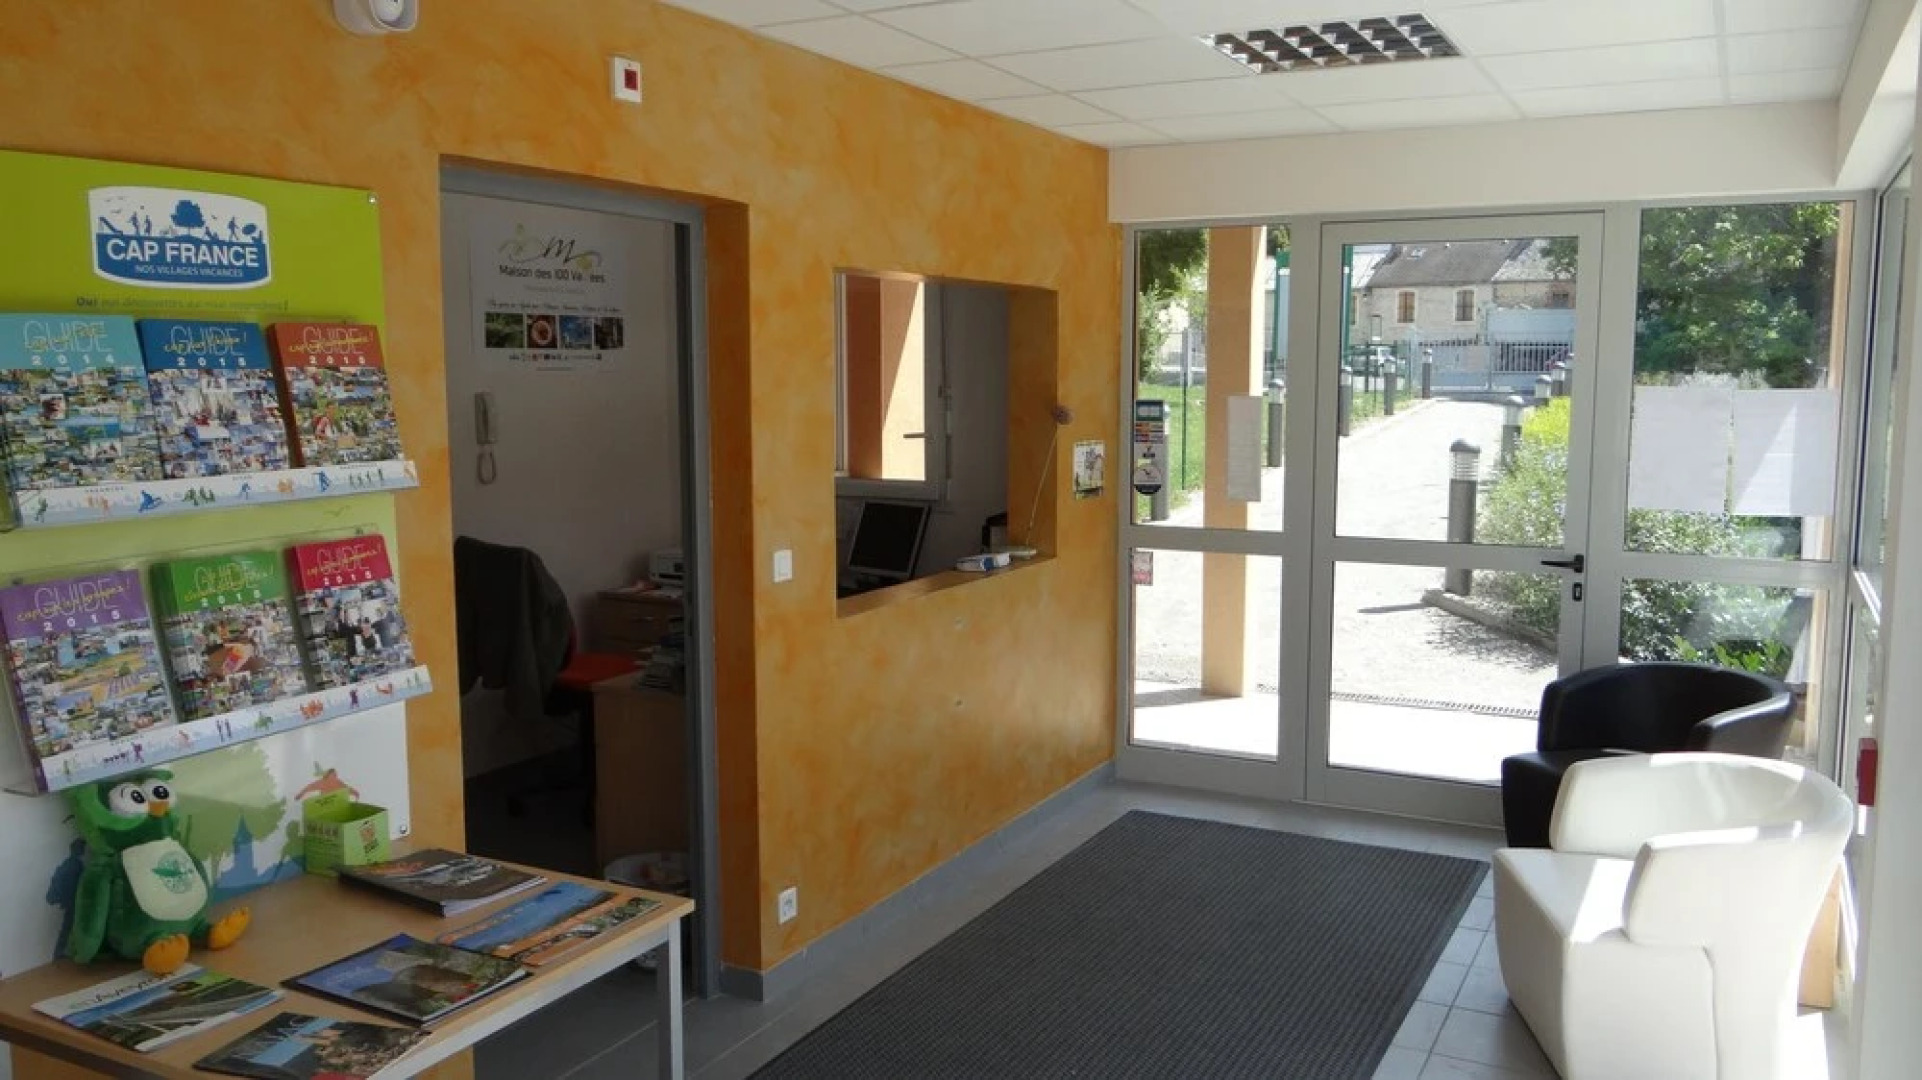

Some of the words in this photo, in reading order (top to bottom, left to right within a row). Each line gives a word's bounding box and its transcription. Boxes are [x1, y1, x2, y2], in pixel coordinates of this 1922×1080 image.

[106, 238, 159, 262] CAP
[165, 242, 260, 268] FRANCE
[134, 265, 154, 274] NOS
[156, 265, 198, 276] VILLAGES
[199, 268, 244, 278] VACANCES
[499, 264, 533, 278] Maison
[534, 269, 553, 280] des
[24, 320, 112, 353] GUIDE
[171, 325, 245, 357] GUIDE
[304, 326, 364, 355] GUIDE
[34, 577, 119, 620] GUIDE
